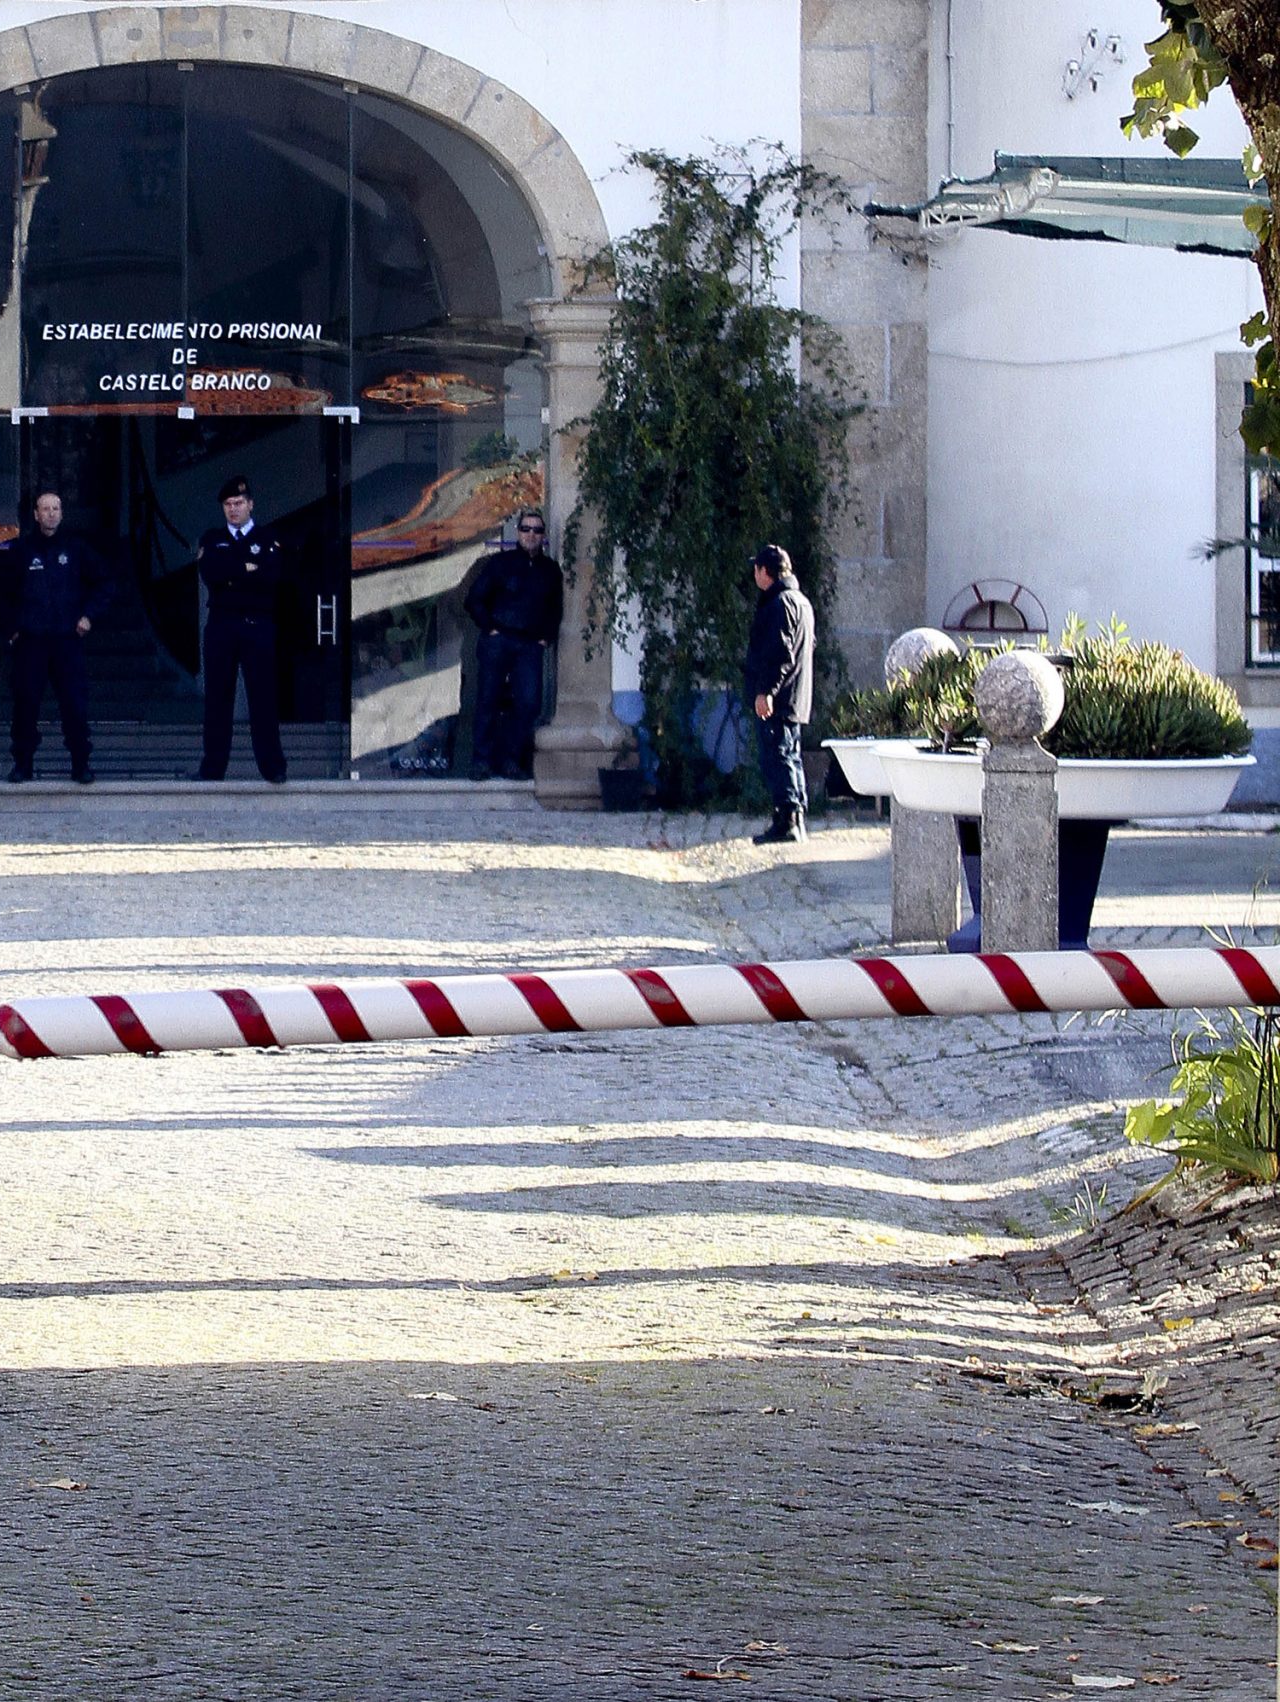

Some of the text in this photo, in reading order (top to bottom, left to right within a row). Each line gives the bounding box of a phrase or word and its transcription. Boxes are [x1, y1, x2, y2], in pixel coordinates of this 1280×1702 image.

[42, 322, 223, 340] ESTABELECIMENTO
[172, 348, 198, 365] DE
[99, 373, 271, 391] CASTELO BRANCO
